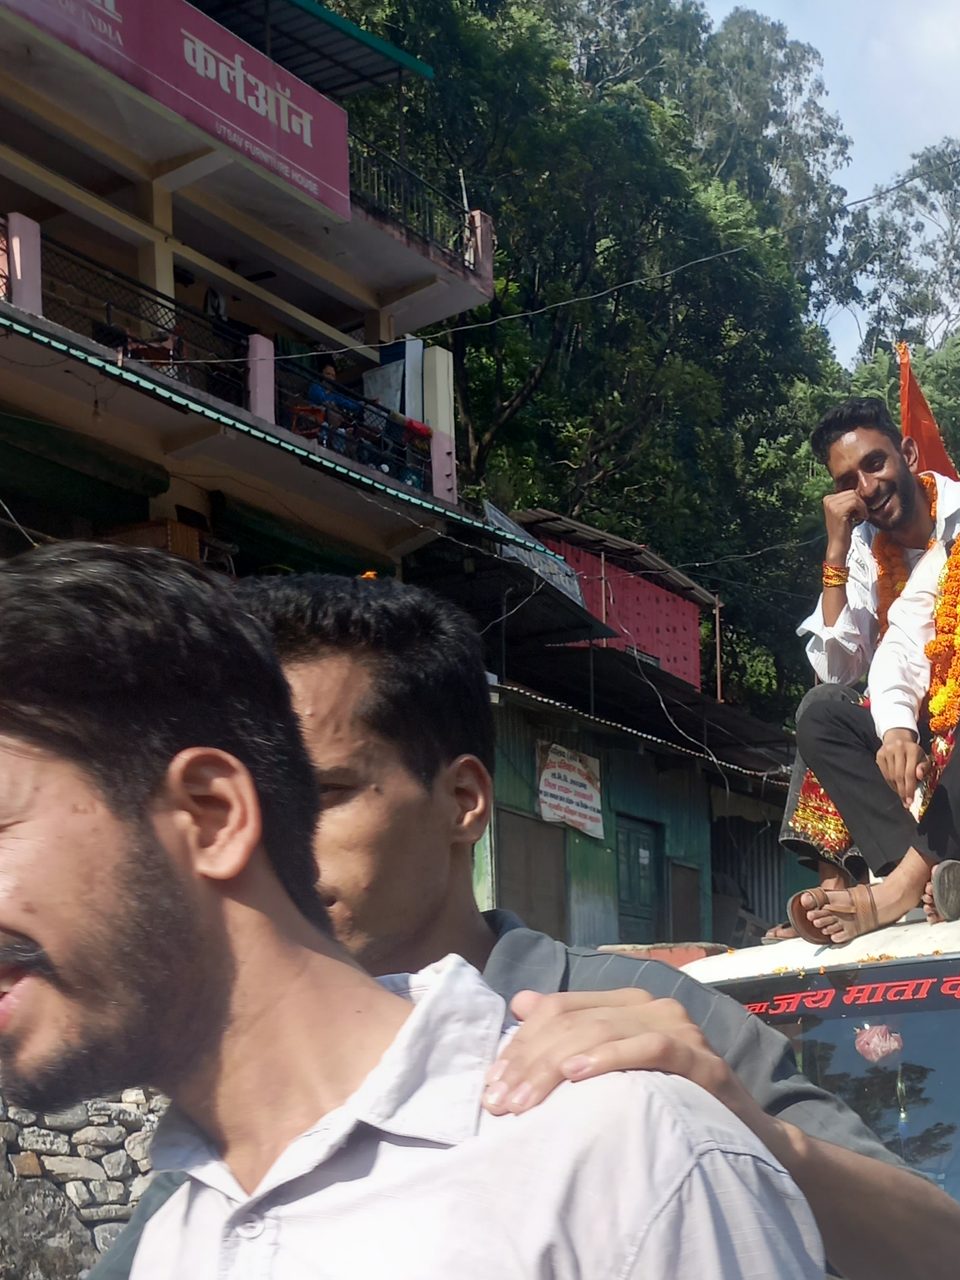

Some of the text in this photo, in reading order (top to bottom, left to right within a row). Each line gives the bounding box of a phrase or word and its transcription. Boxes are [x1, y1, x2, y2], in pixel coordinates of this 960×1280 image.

[244, 140, 290, 177] FURNITURE
[291, 169, 320, 195] HOUSE
[769, 989, 836, 1014] जय
[842, 978, 937, 1005] माता
